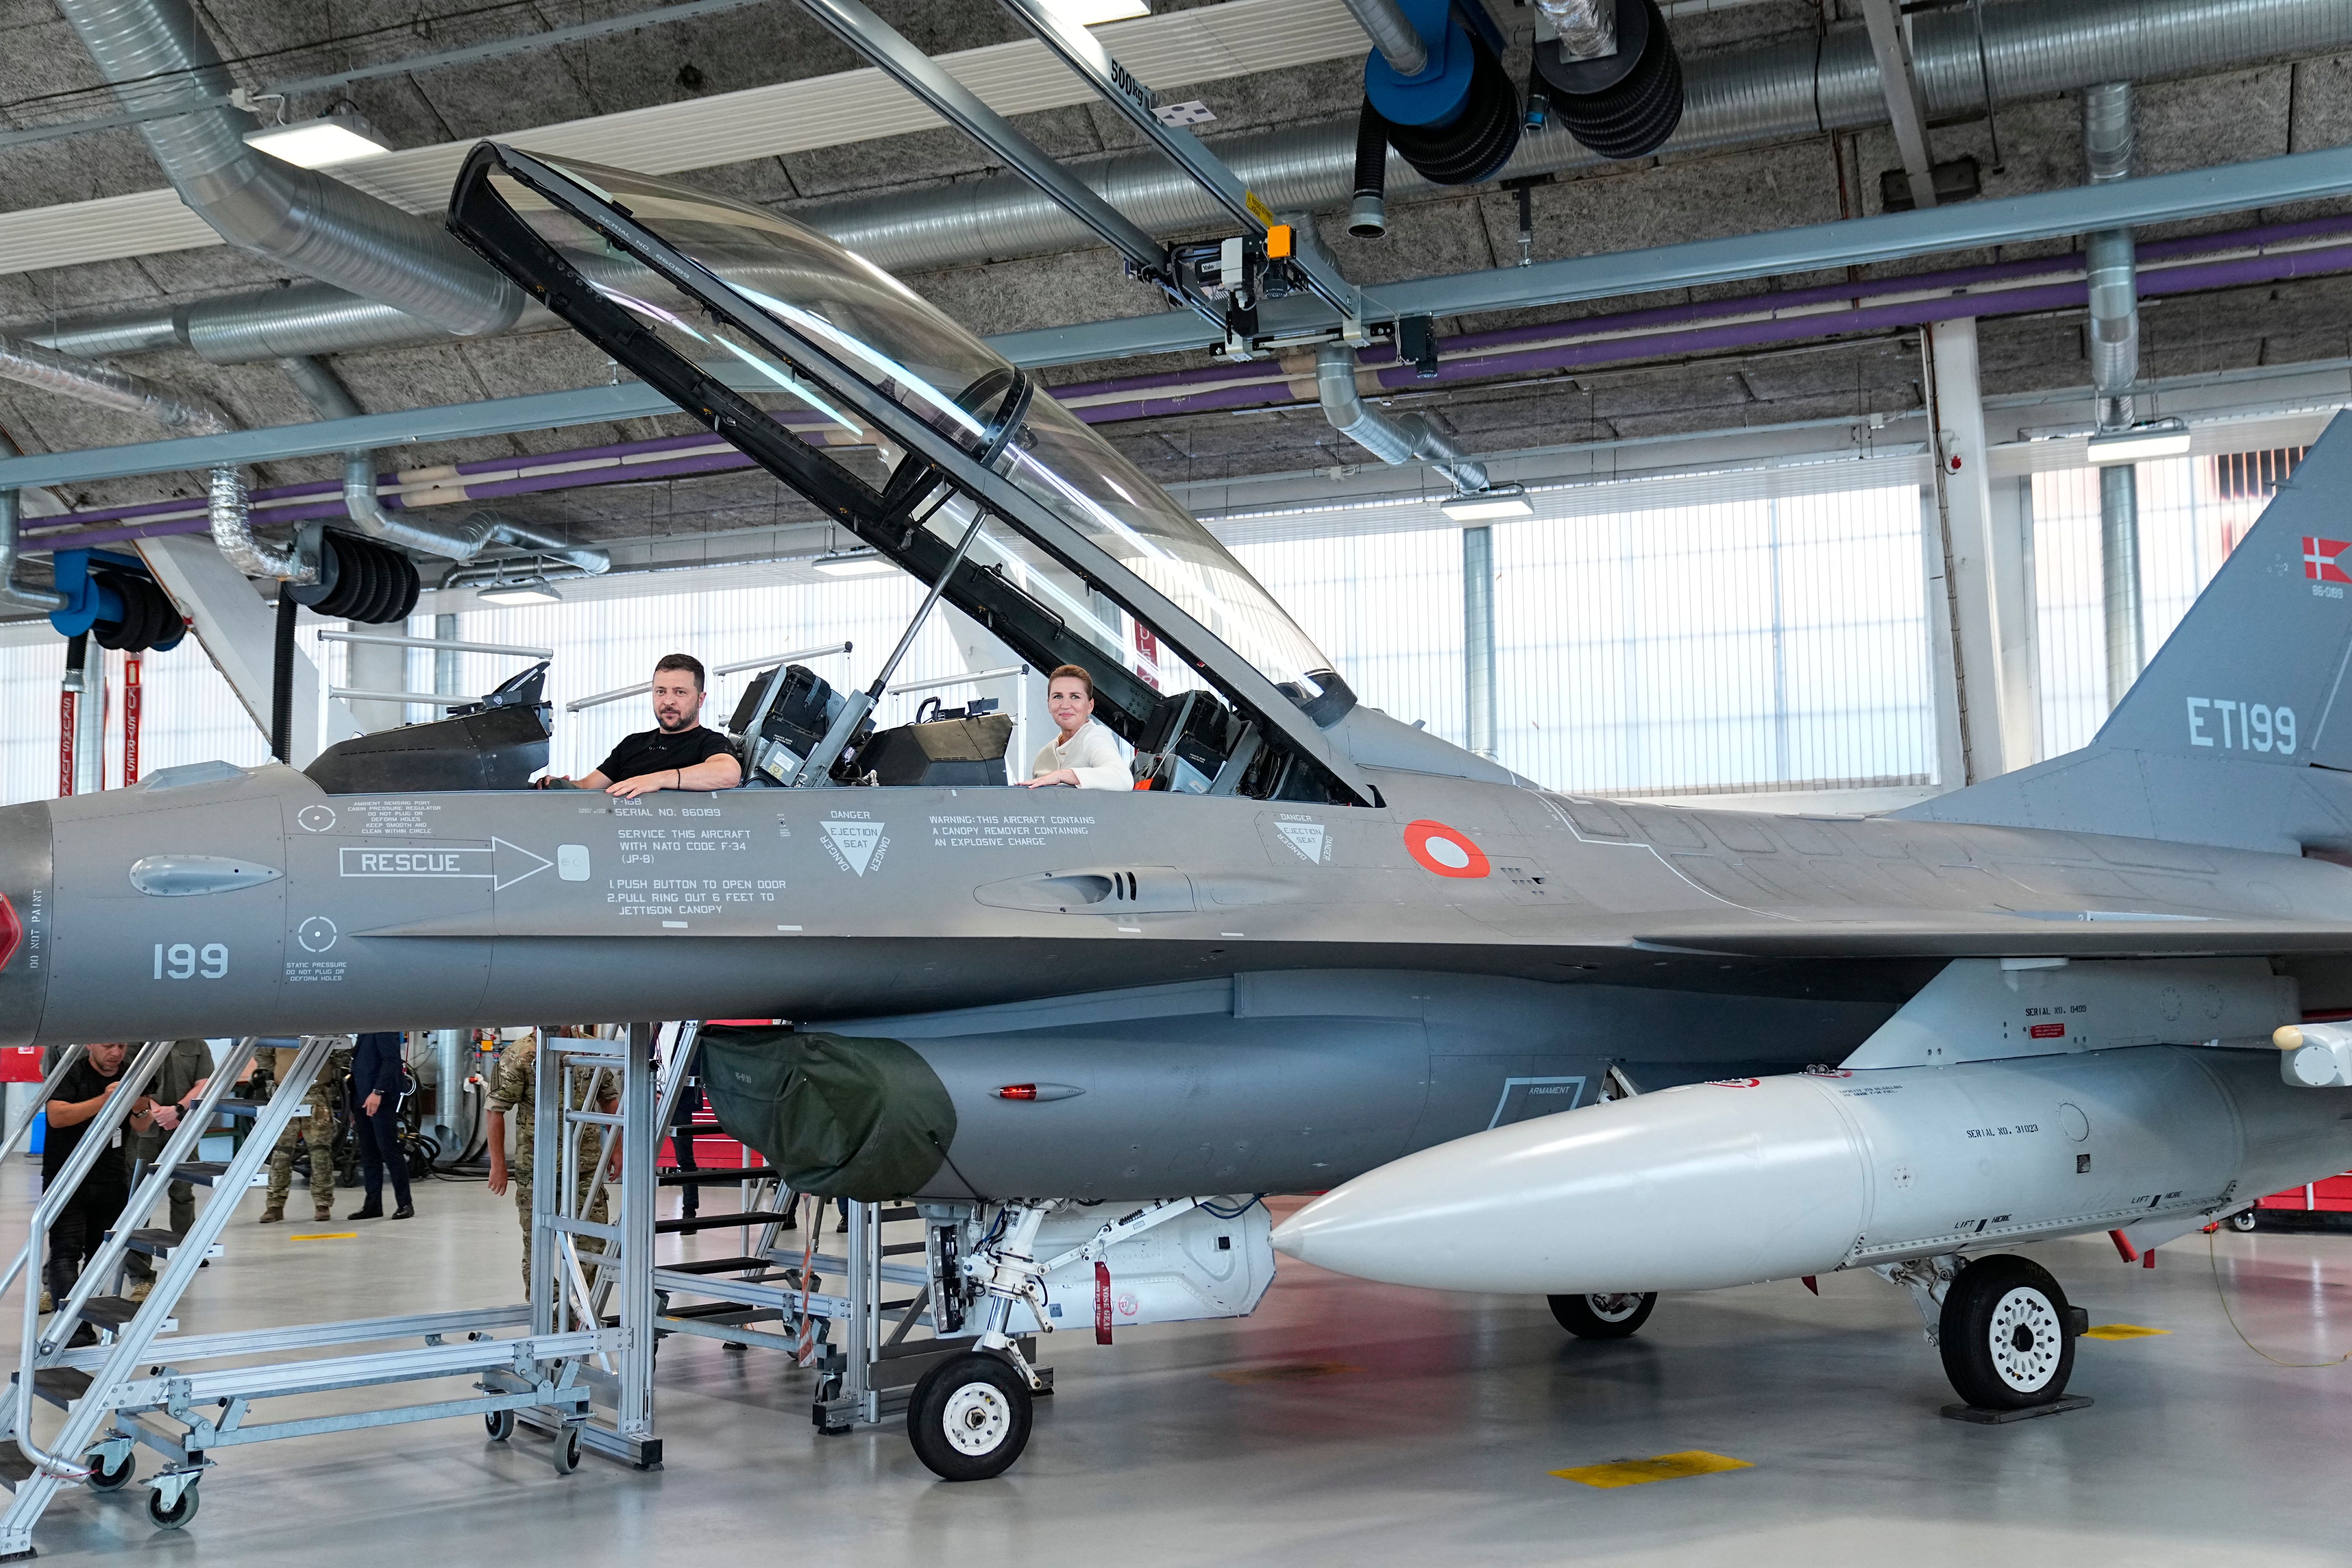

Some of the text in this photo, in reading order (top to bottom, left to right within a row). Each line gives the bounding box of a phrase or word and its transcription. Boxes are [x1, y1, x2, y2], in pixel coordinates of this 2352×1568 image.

[1111, 58, 1143, 106] 500kg
[599, 215, 690, 279] SERIAL NO. 860199
[2187, 697, 2297, 755] ET199
[830, 811, 871, 819] DANGER
[1280, 813, 1312, 822] DANGER
[618, 830, 750, 838] SERVICE THIS AIRCRAFT
[830, 828, 878, 837] EJECTION
[620, 842, 746, 851] WITH NATO CODE F-34
[843, 840, 868, 848] SEAT
[1277, 833, 1308, 861] DANGER
[1323, 836, 1333, 861] DANGER
[622, 854, 654, 864] (JP-8)
[820, 835, 850, 872] DANGER
[870, 836, 890, 872] DANGER
[362, 854, 460, 872] RESCUE
[654, 880, 696, 889] BUTTON
[703, 880, 717, 889] TO
[722, 880, 752, 889] OPEN
[758, 880, 786, 889] DOOR
[652, 893, 678, 903] RING
[685, 893, 706, 902] OUT
[713, 893, 720, 902] 6
[726, 893, 754, 902] FEET
[619, 905, 722, 915] JETTISON CANOPY
[30, 890, 43, 968] DO NOT PAINT
[154, 944, 229, 979] 199
[2026, 1008, 2050, 1016] SERIAL
[1529, 1086, 1570, 1095] ARMAMENT
[1966, 1124, 2038, 1139] SERIAL NO. 31023
[2131, 1191, 2182, 1204] LIFT HERE
[1955, 1214, 2012, 1229] LIFT HERE
